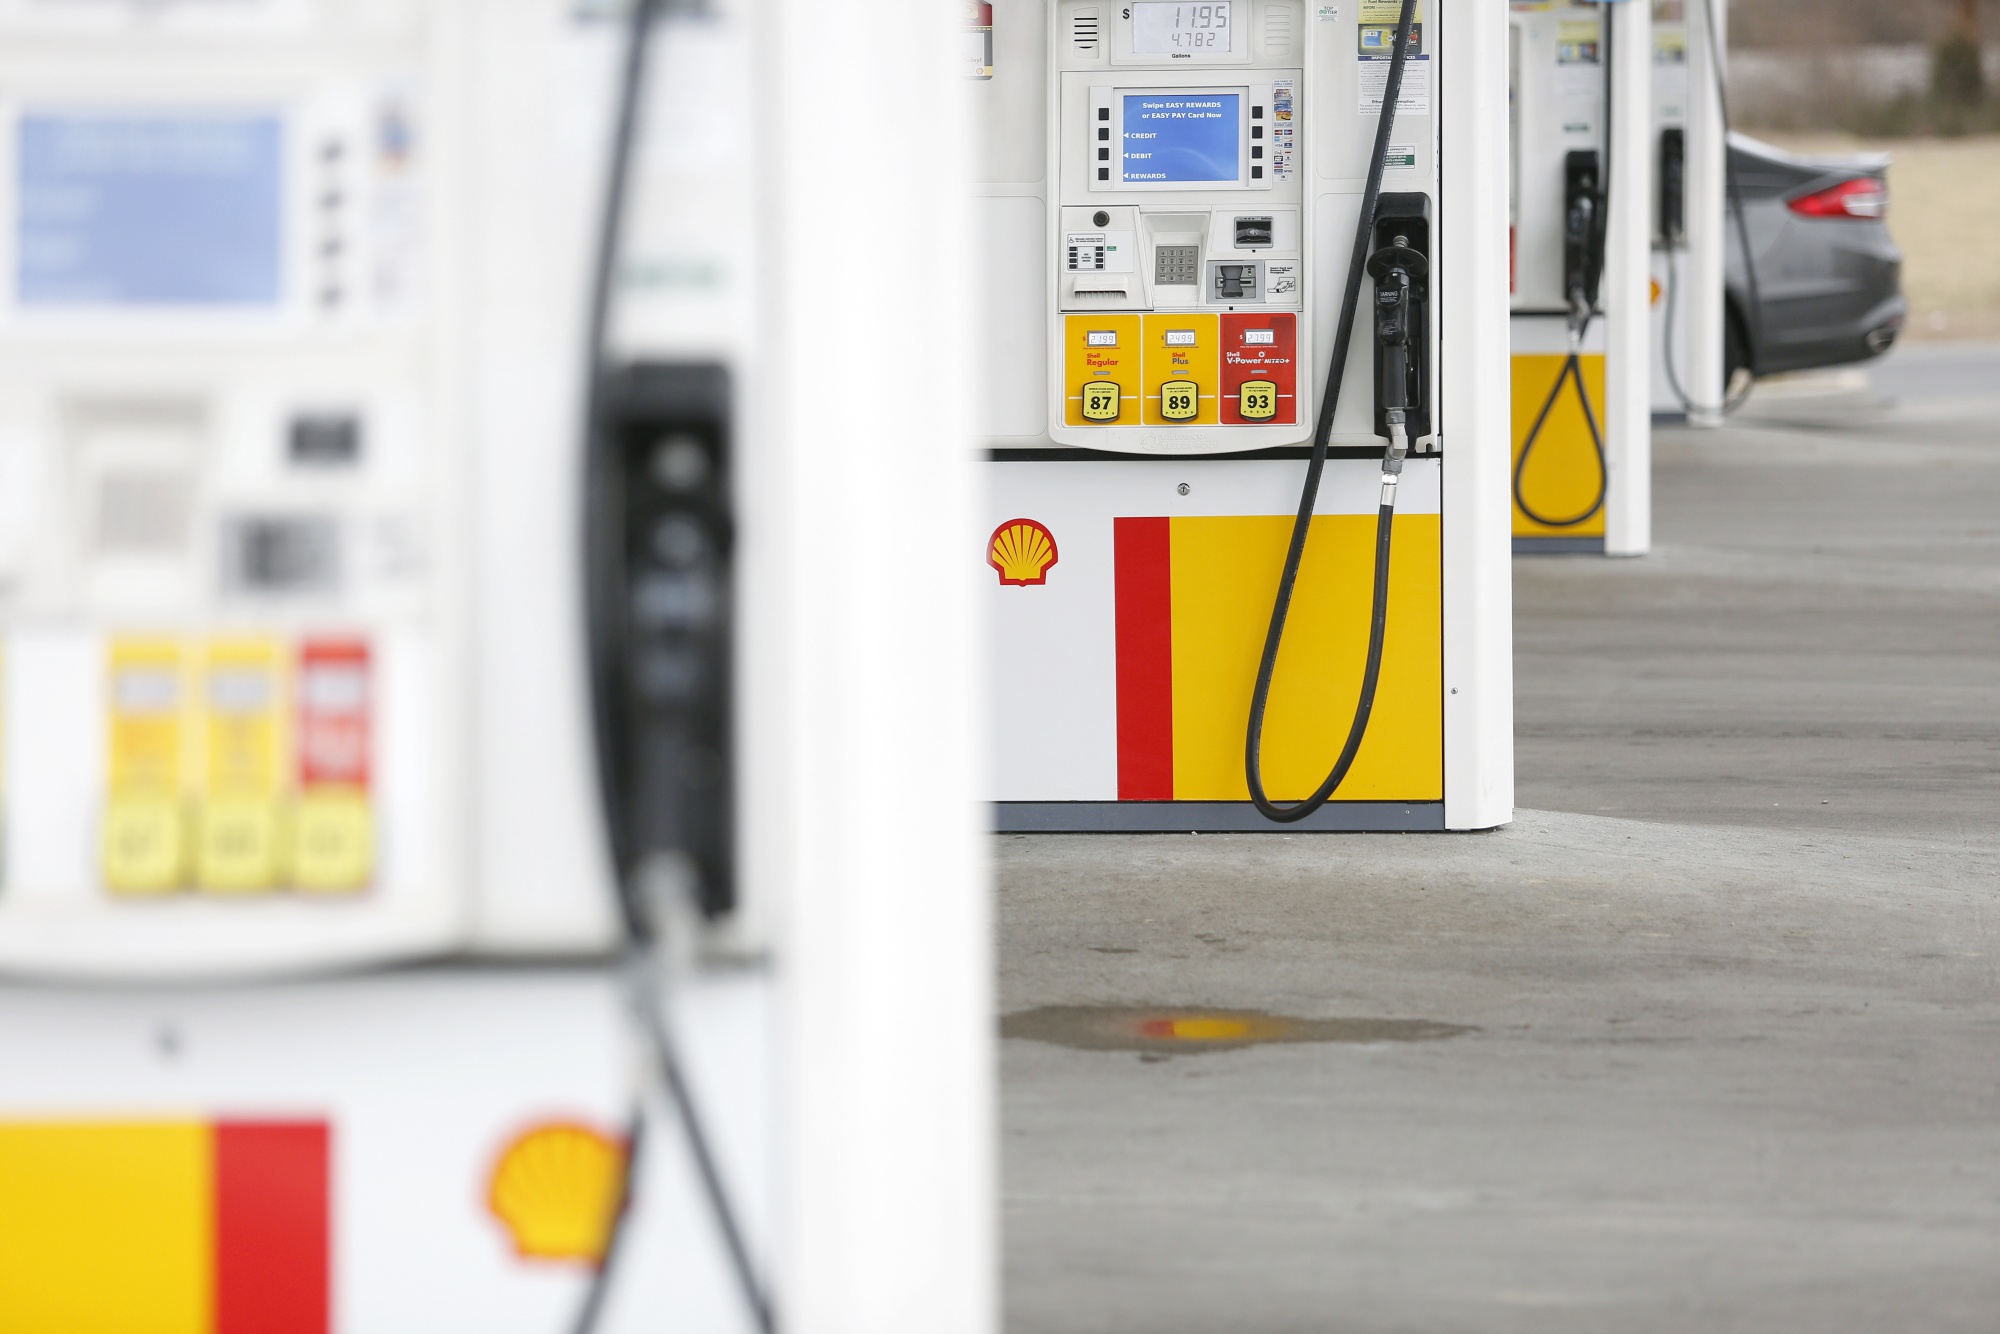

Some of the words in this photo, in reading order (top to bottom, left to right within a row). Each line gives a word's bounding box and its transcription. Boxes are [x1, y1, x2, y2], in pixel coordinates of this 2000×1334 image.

[1122, 8, 1130, 20] $
[1176, 6, 1226, 28] 11.95
[1172, 32, 1215, 46] 4.782
[1087, 358, 1119, 367] Regular
[1090, 396, 1112, 410] 87
[1169, 396, 1190, 409] 89
[1247, 395, 1268, 408] 93
